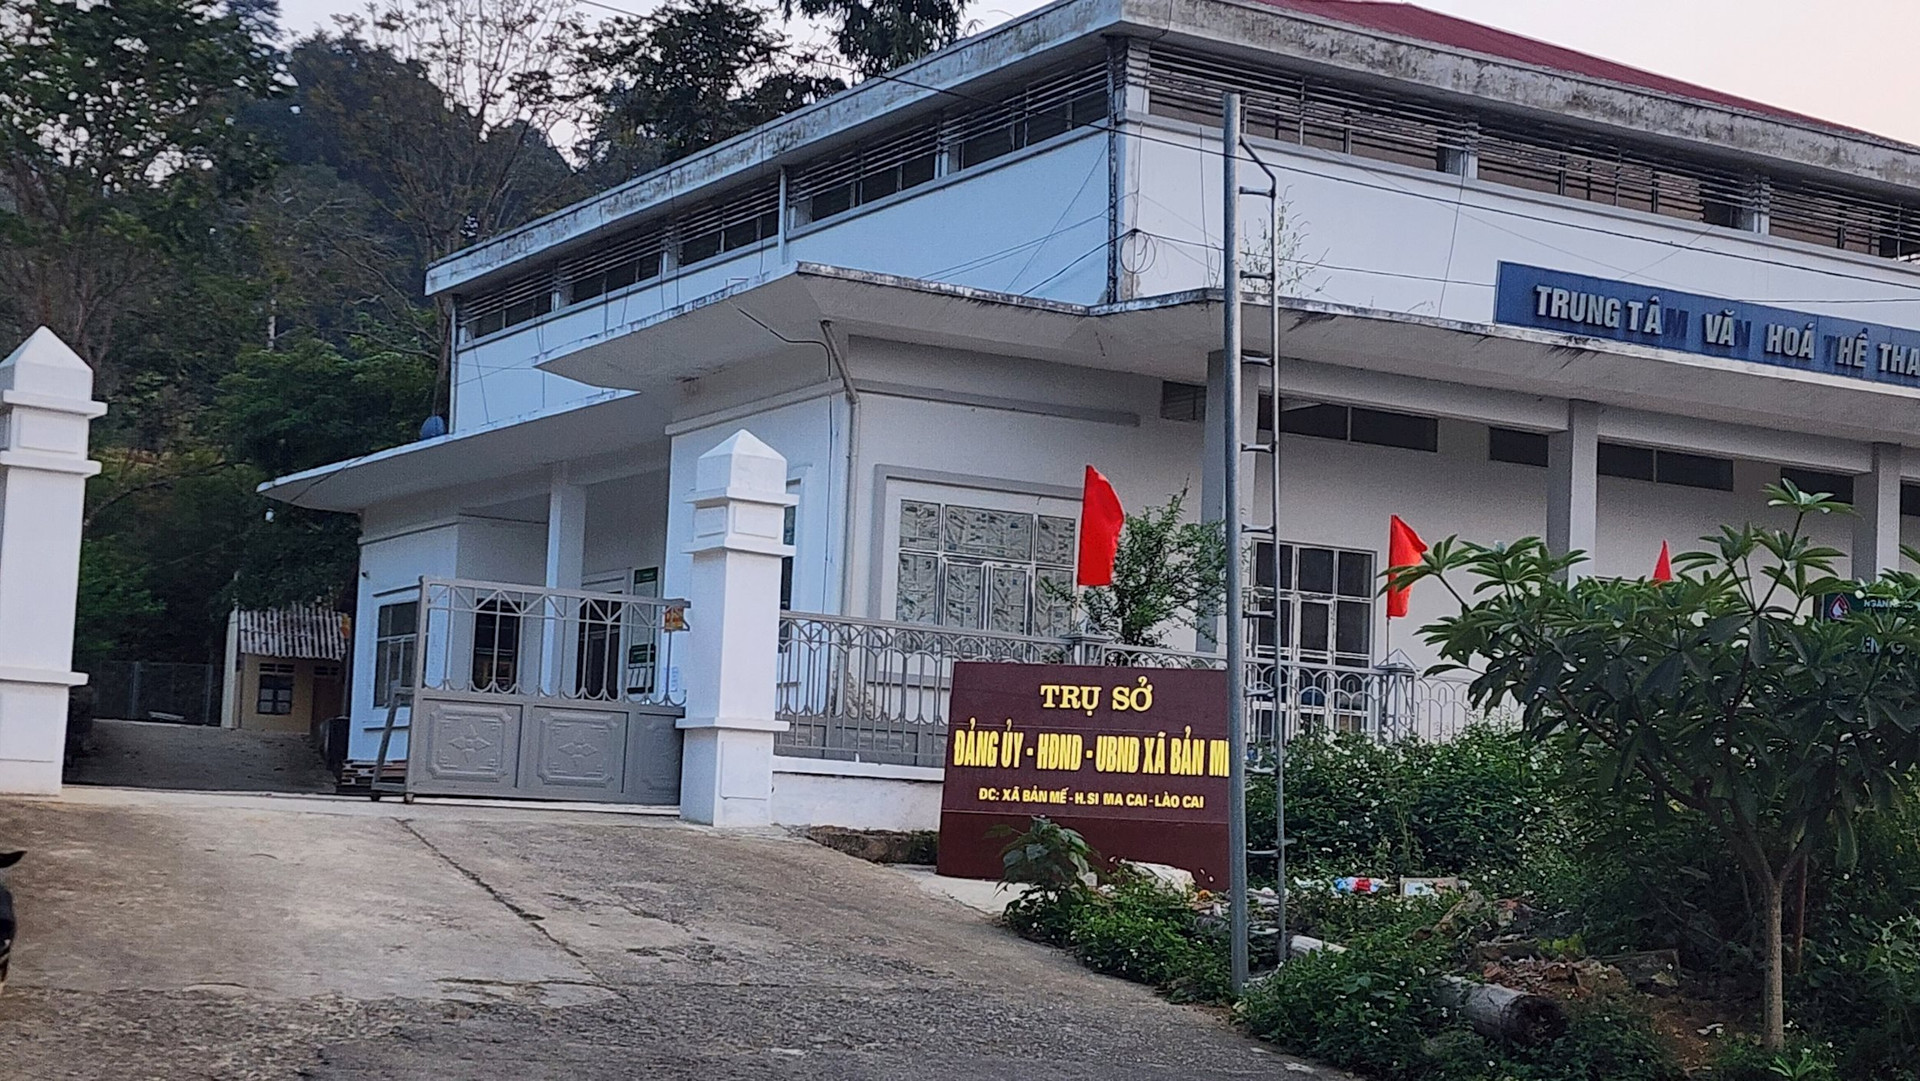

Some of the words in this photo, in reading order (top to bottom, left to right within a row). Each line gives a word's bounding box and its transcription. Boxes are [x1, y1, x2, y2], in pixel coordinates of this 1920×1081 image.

[1535, 284, 1620, 327] TRUNG
[1766, 322, 1815, 359] HOÁ
[1040, 684, 1102, 716] TRỤ
[1112, 676, 1154, 712] SỞ
[954, 717, 998, 768] ĐẢNG
[1001, 718, 1024, 768] ỦY
[1036, 733, 1083, 771] HĐND
[1095, 735, 1140, 774] UBND
[1142, 731, 1165, 775] XÃ
[1170, 725, 1206, 776] BẢN
[978, 787, 1000, 801] ĐC:
[1002, 786, 1020, 802] XÃ
[1022, 784, 1048, 803] BẢN
[1103, 793, 1123, 807] MA
[1155, 792, 1180, 808] LÀO
[1183, 796, 1204, 808] CAI
